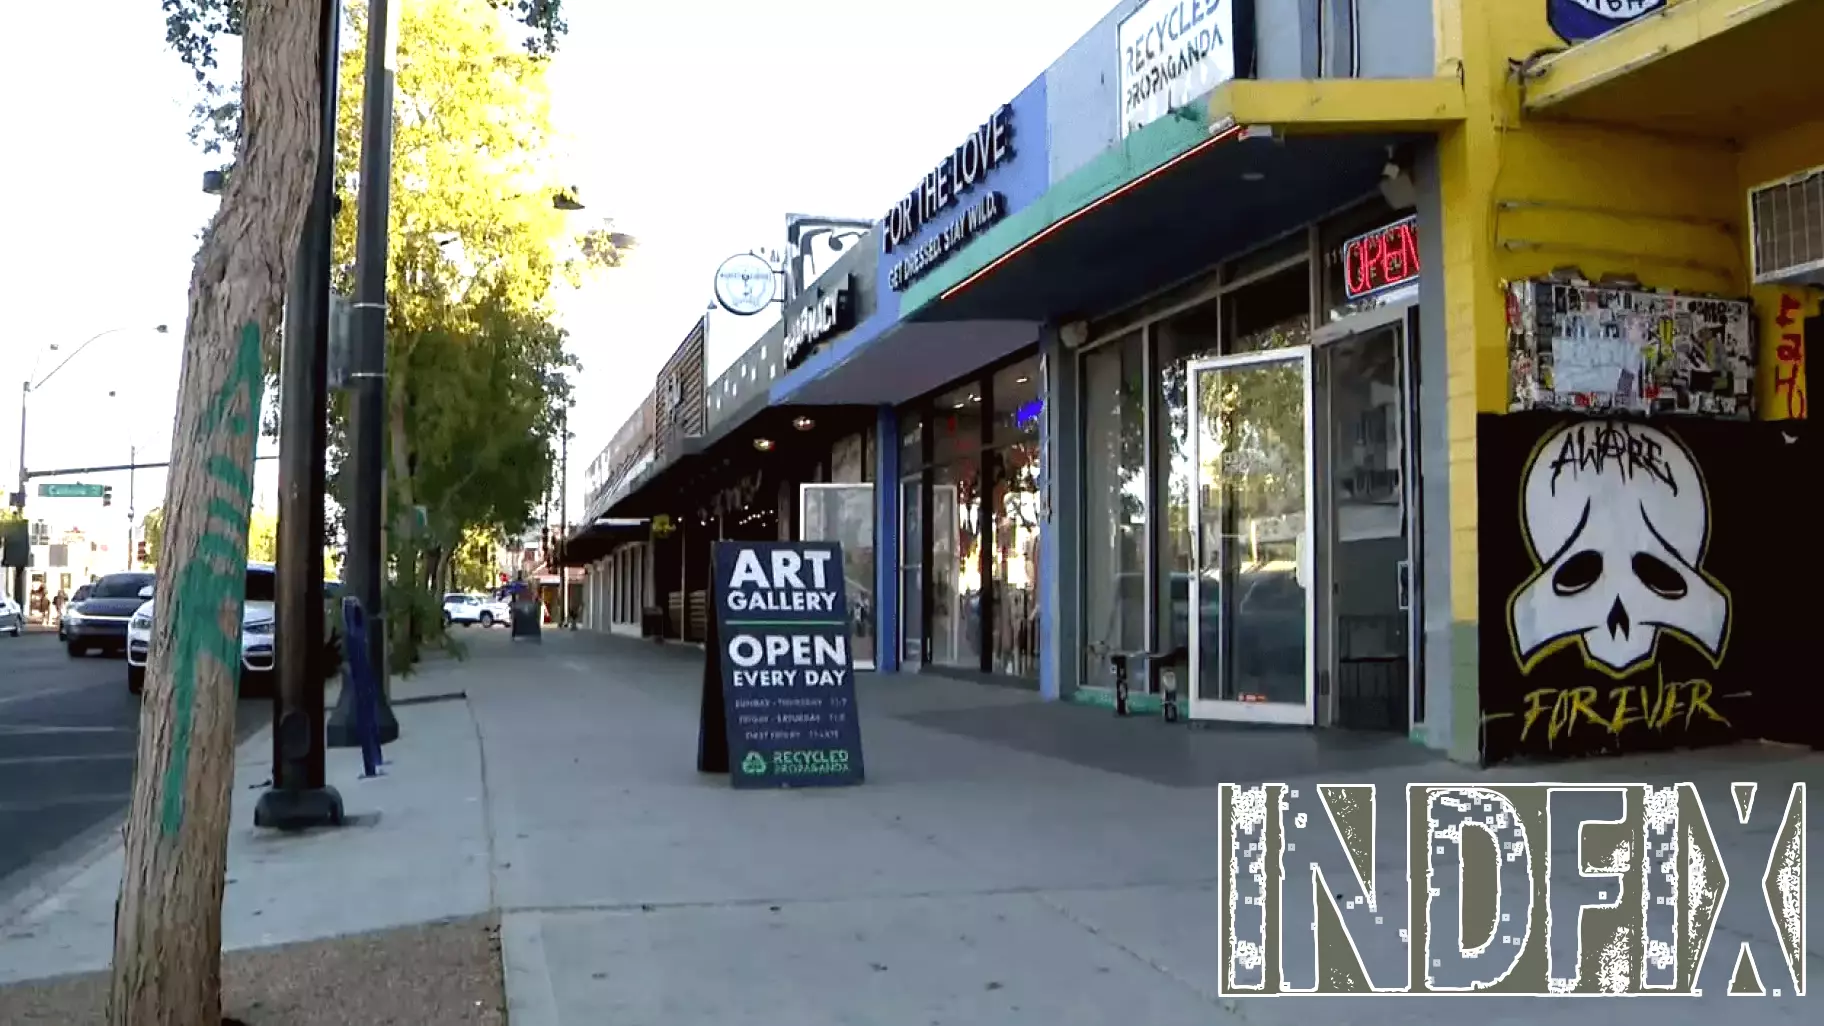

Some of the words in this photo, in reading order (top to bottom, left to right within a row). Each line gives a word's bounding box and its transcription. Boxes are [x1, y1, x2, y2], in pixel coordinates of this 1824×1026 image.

[1126, 24, 1224, 113] PROPAGANDA
[882, 193, 913, 254] FOR
[917, 161, 948, 225] THE
[952, 105, 1007, 196] LOVE
[888, 260, 903, 290] GET
[943, 211, 966, 251] STAY
[1347, 223, 1420, 294] OPEN
[1551, 420, 1678, 498] AWARE
[727, 591, 837, 611] GALLERY
[728, 549, 832, 590] ART
[728, 634, 847, 667] OPEN
[733, 670, 797, 687] EVERY
[805, 669, 847, 687] DAY
[1520, 661, 1732, 746] FOREVER
[772, 750, 849, 764] RECYCLED
